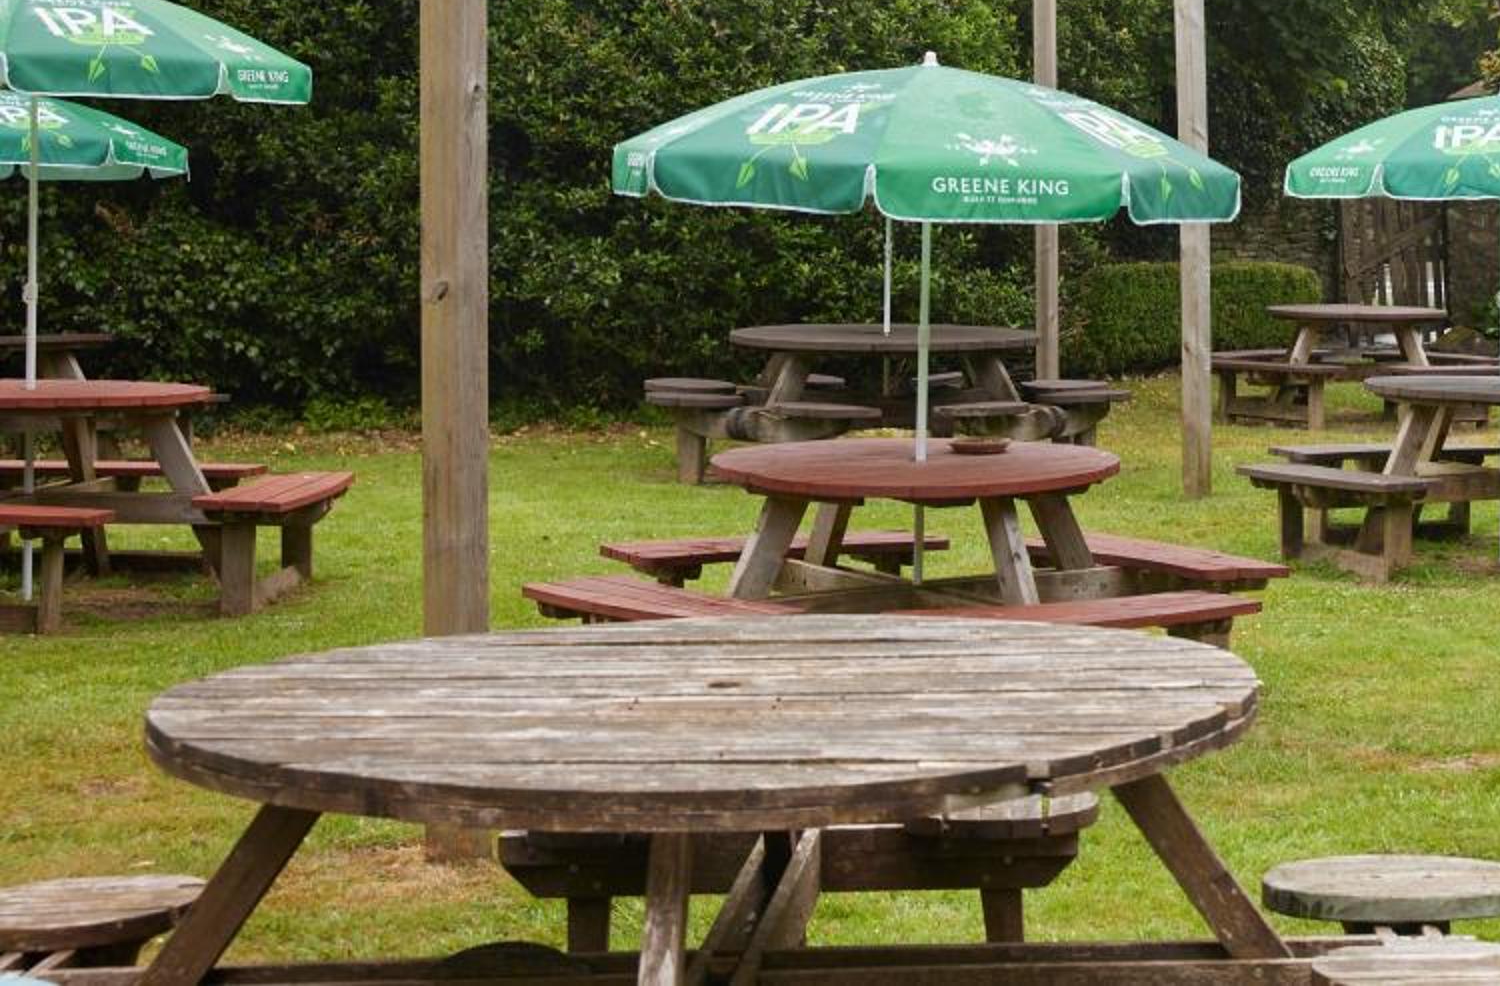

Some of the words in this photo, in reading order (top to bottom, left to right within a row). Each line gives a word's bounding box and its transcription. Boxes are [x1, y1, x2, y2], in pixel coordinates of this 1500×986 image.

[33, 6, 155, 37] IPA
[0, 106, 70, 124] PA
[745, 103, 861, 134] IPA
[931, 177, 1010, 194] GREENE
[1017, 178, 1069, 196] KING
